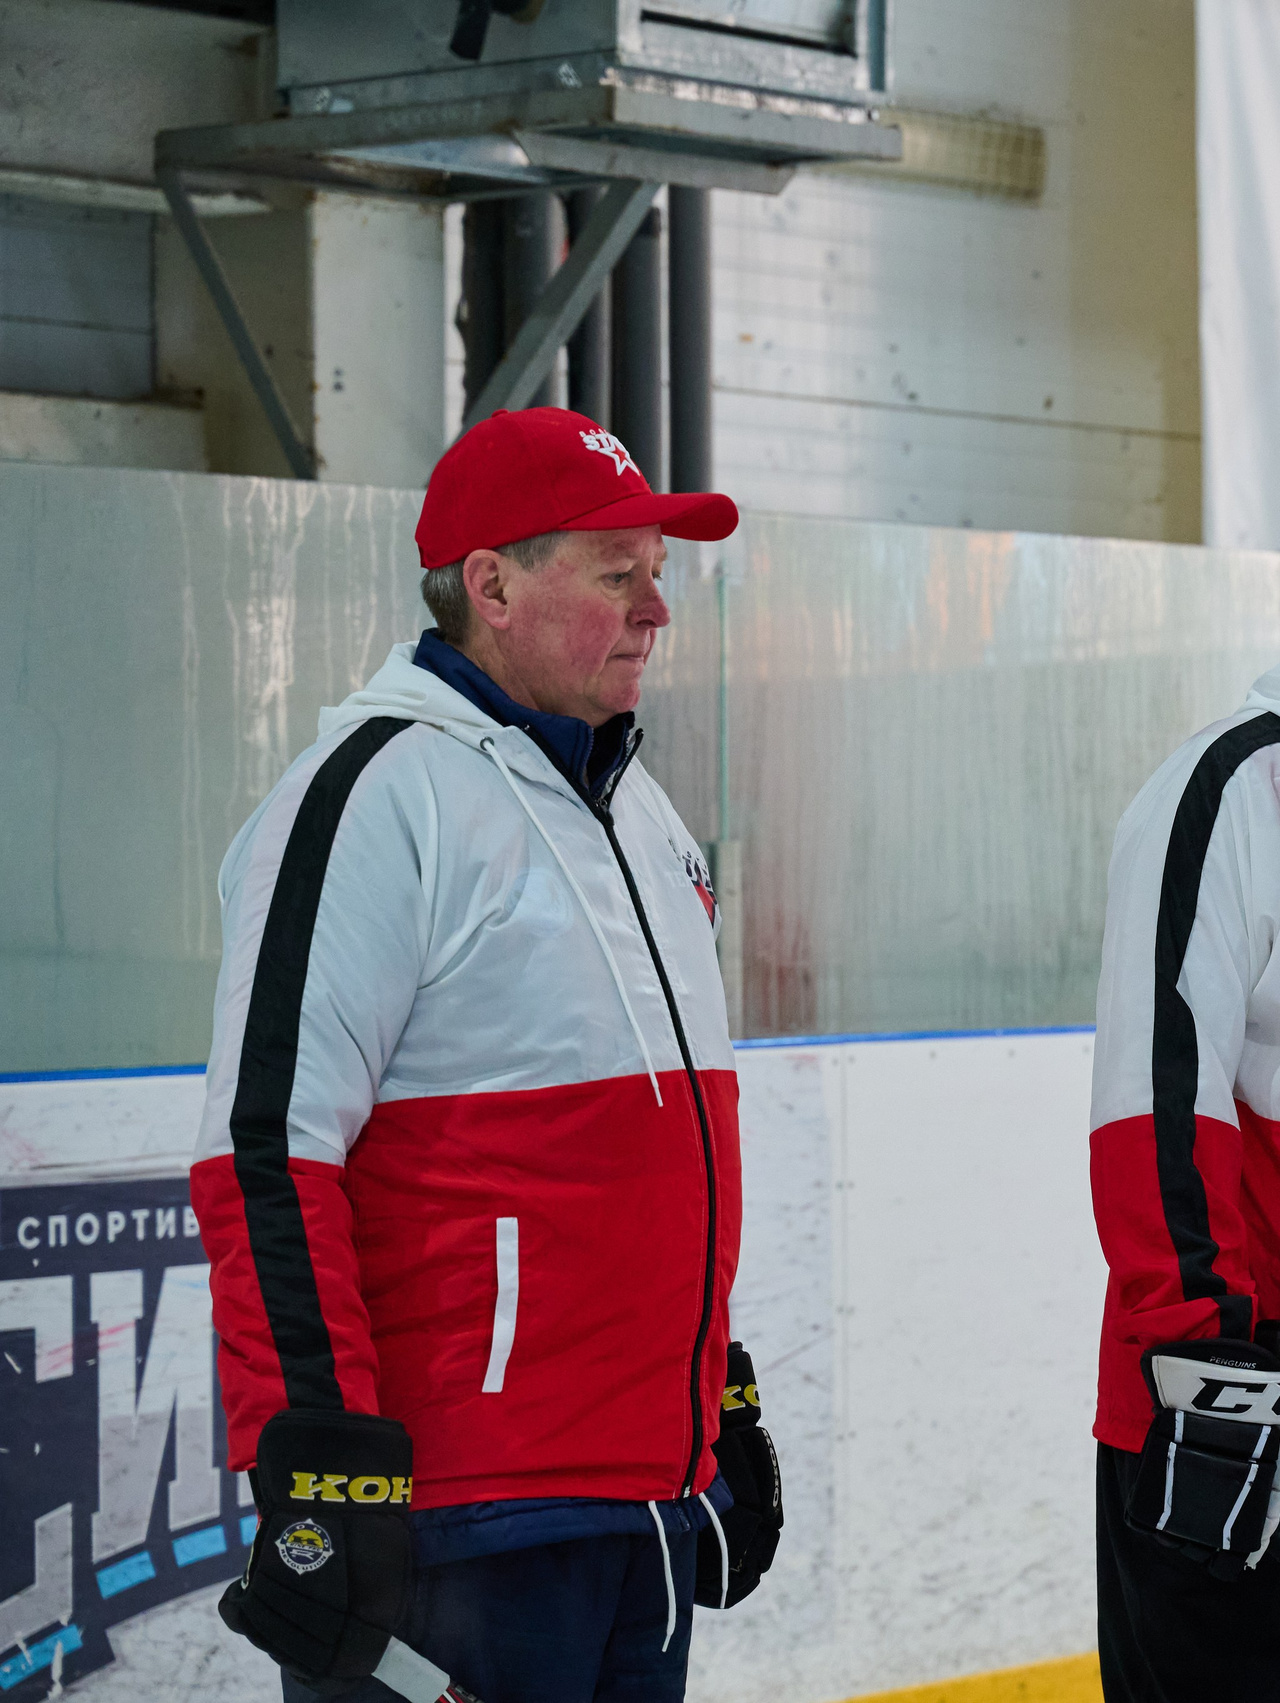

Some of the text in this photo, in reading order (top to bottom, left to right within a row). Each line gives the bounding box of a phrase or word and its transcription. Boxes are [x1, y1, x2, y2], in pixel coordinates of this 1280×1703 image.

[17, 1205, 200, 1250] СПОРТИВ
[1210, 1355, 1257, 1370] PENGUINS
[283, 1524, 329, 1548] KOHO
[280, 1547, 327, 1571] REVOLUTION
